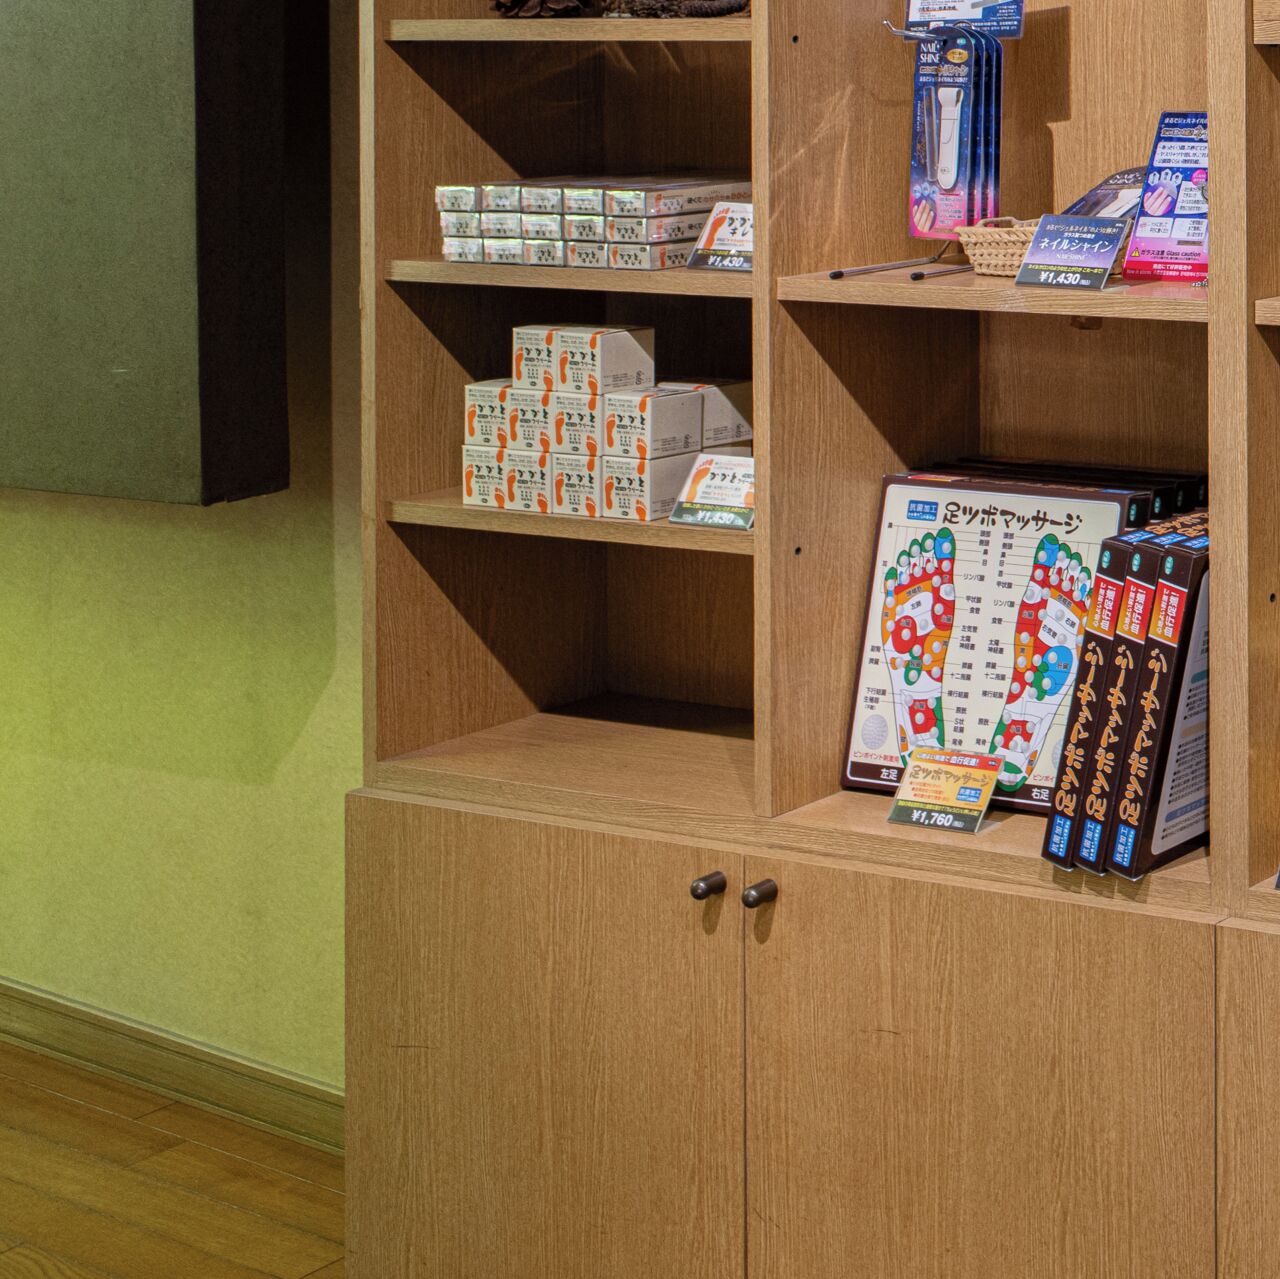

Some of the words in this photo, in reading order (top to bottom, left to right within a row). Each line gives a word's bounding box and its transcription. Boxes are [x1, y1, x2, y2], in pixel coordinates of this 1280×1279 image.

[921, 43, 937, 52] NAIL
[1040, 239, 1113, 253] ネイルシャイン
[708, 256, 743, 266] ¥1,430
[1040, 272, 1080, 284] ¥1,430
[943, 502, 1083, 533] 足ツボマッサージ
[1055, 641, 1104, 817] 足ツボマッサージ
[880, 769, 897, 780] 左足
[1032, 789, 1049, 799] 右足
[911, 810, 953, 826] ¥1,760
